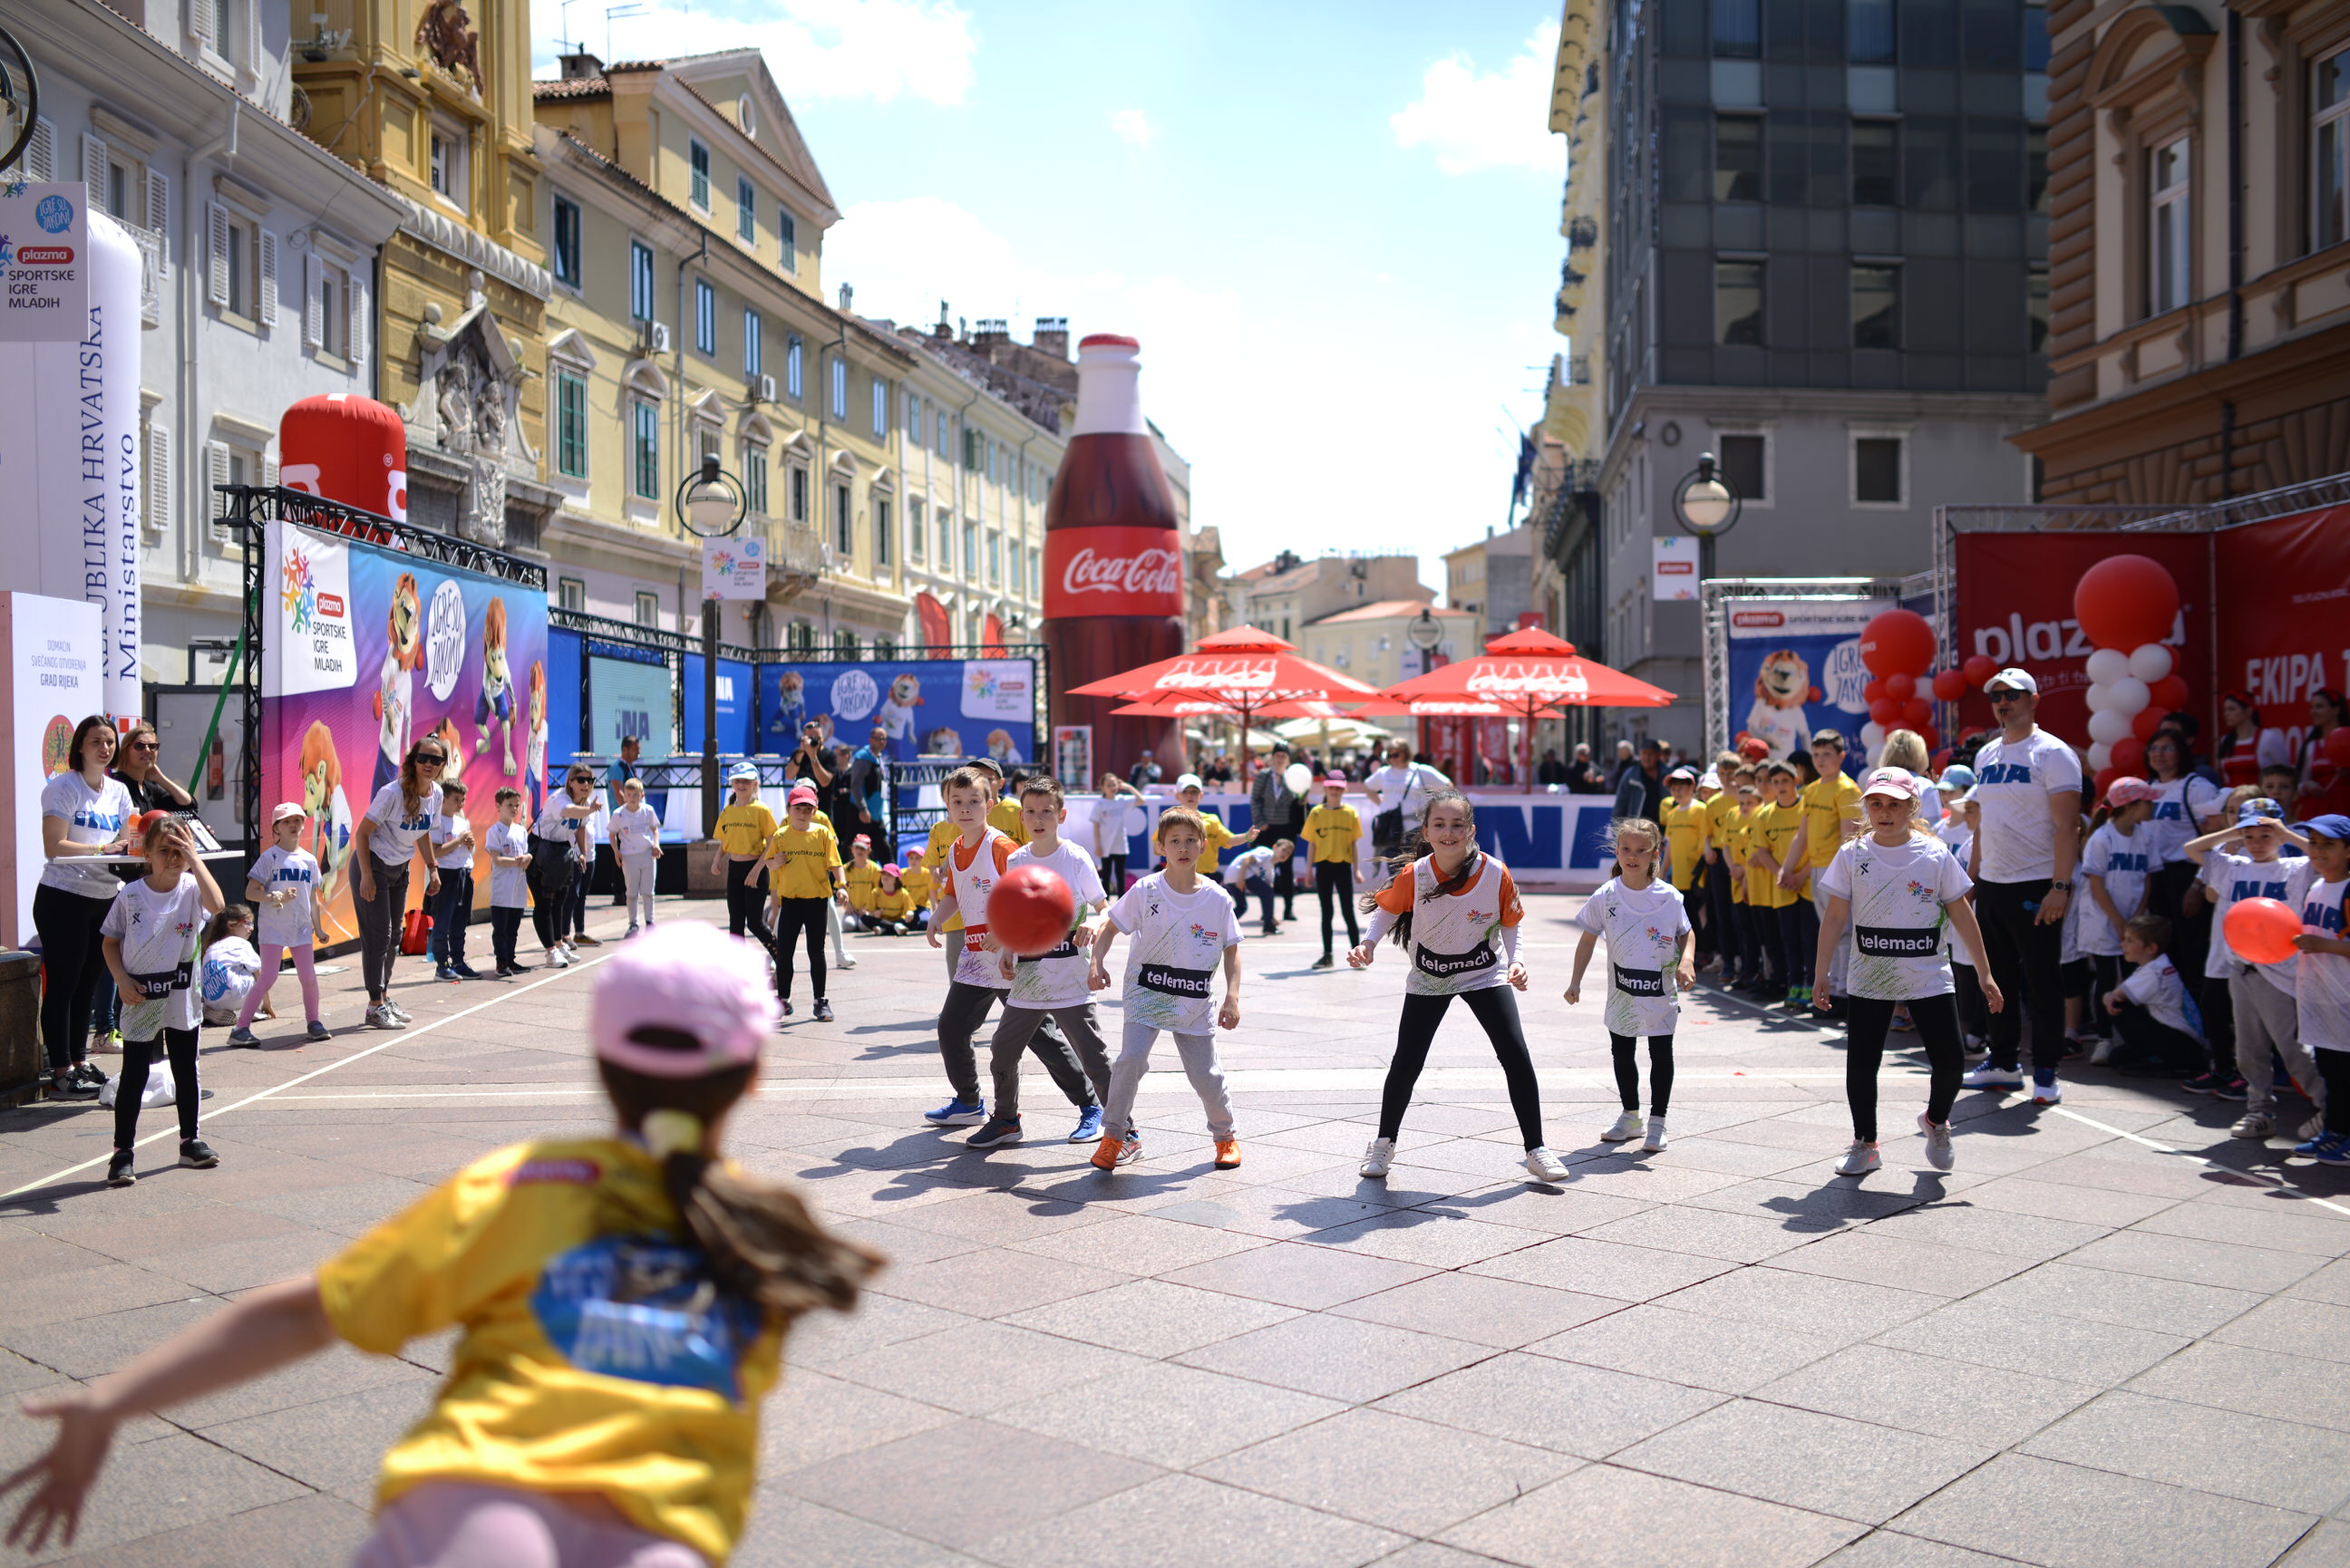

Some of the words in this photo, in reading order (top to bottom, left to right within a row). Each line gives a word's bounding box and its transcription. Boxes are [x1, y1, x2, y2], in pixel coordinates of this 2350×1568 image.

[22, 249, 68, 262] plazma
[8, 269, 75, 282] SPORTSKE
[8, 284, 38, 295] IGRE
[8, 297, 61, 308] MLADIH
[118, 433, 138, 682] Ministarstvo
[1063, 547, 1178, 595] Coca-Cola
[318, 595, 341, 612] plazma
[312, 621, 346, 640] SPORTSKE
[313, 639, 329, 654] IGRE
[314, 657, 343, 673] MLADIH
[40, 673, 57, 687] GRAD
[58, 674, 79, 690] RIJEKA
[2246, 651, 2328, 706] EKIPA
[616, 708, 650, 740] INA
[74, 810, 122, 832] INA
[272, 867, 311, 884] INA
[1860, 934, 1934, 951] telemach
[1421, 950, 1491, 973] telemach
